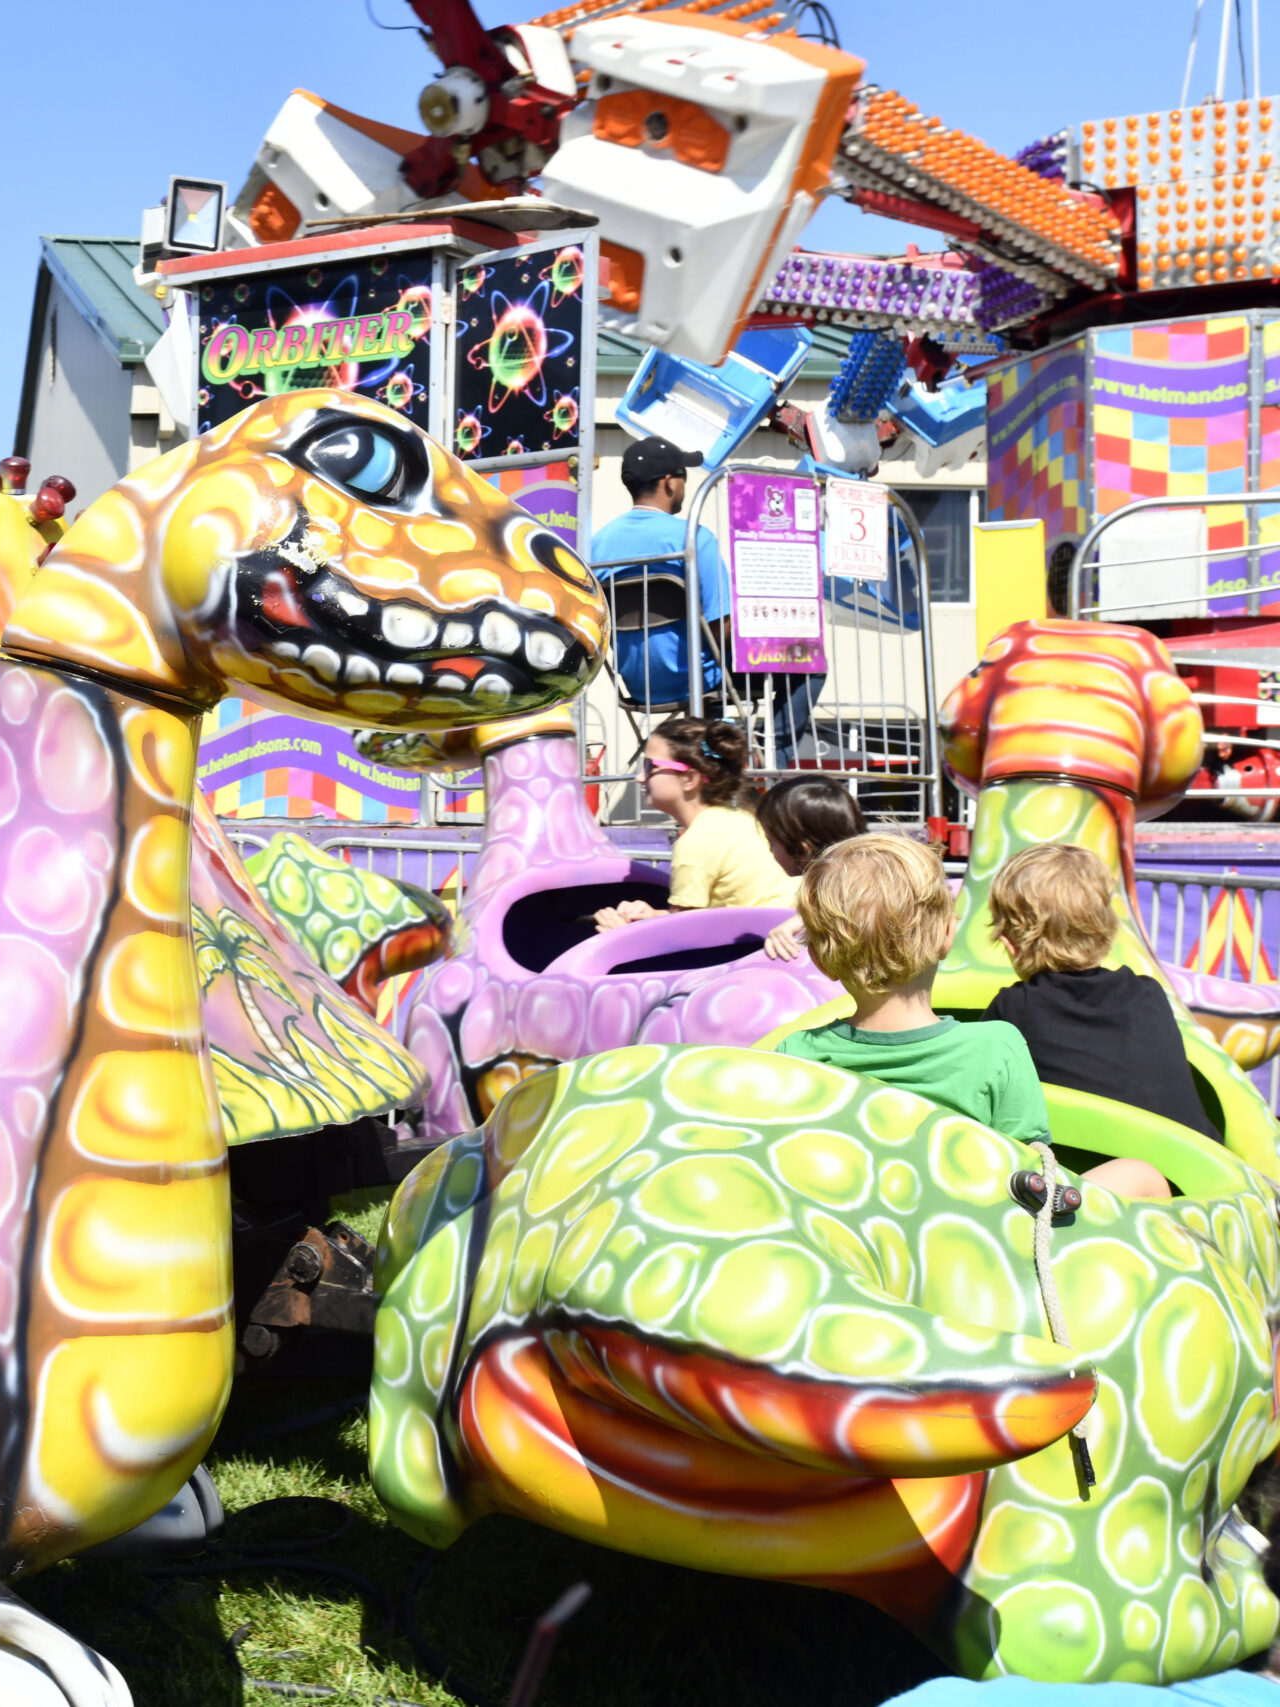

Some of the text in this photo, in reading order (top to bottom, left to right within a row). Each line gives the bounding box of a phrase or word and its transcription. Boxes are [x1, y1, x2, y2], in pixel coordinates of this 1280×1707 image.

[204, 310, 414, 382] ORBITER
[849, 507, 867, 542] 3
[833, 545, 883, 563] TICKETS
